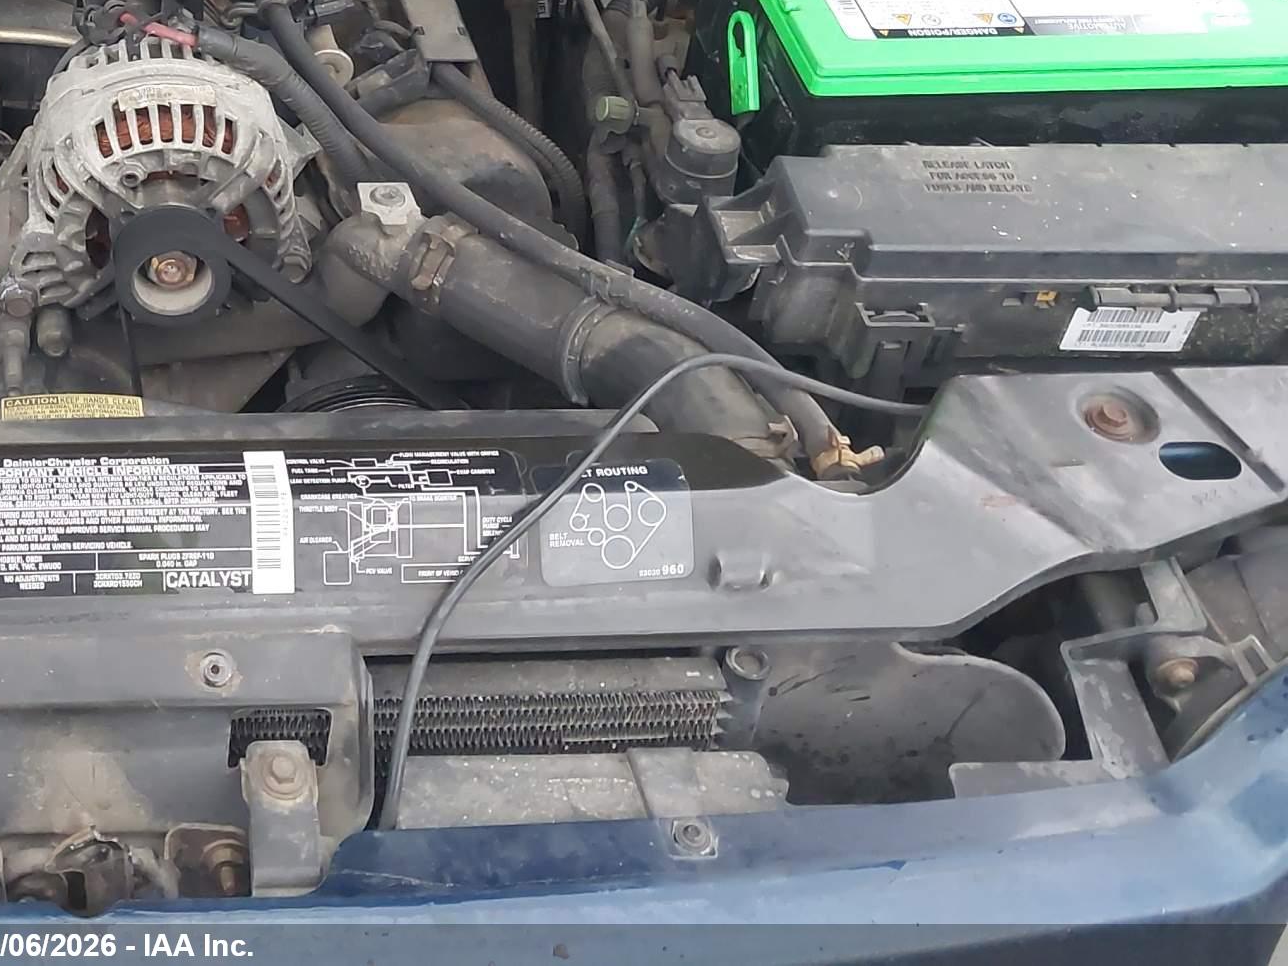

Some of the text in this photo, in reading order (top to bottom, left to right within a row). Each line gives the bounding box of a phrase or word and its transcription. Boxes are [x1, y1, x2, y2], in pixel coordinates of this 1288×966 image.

[6, 397, 57, 407] CAUTION
[3, 456, 170, 468] DaimlerChrysler Corporation
[57, 467, 109, 475] VEHICLE
[112, 465, 200, 475] INFORMATION
[596, 466, 649, 477] ROUTING
[549, 532, 569, 541] BELT
[549, 538, 585, 548] REMOVAL
[661, 563, 685, 575] 960
[166, 570, 252, 588] CATALYST
